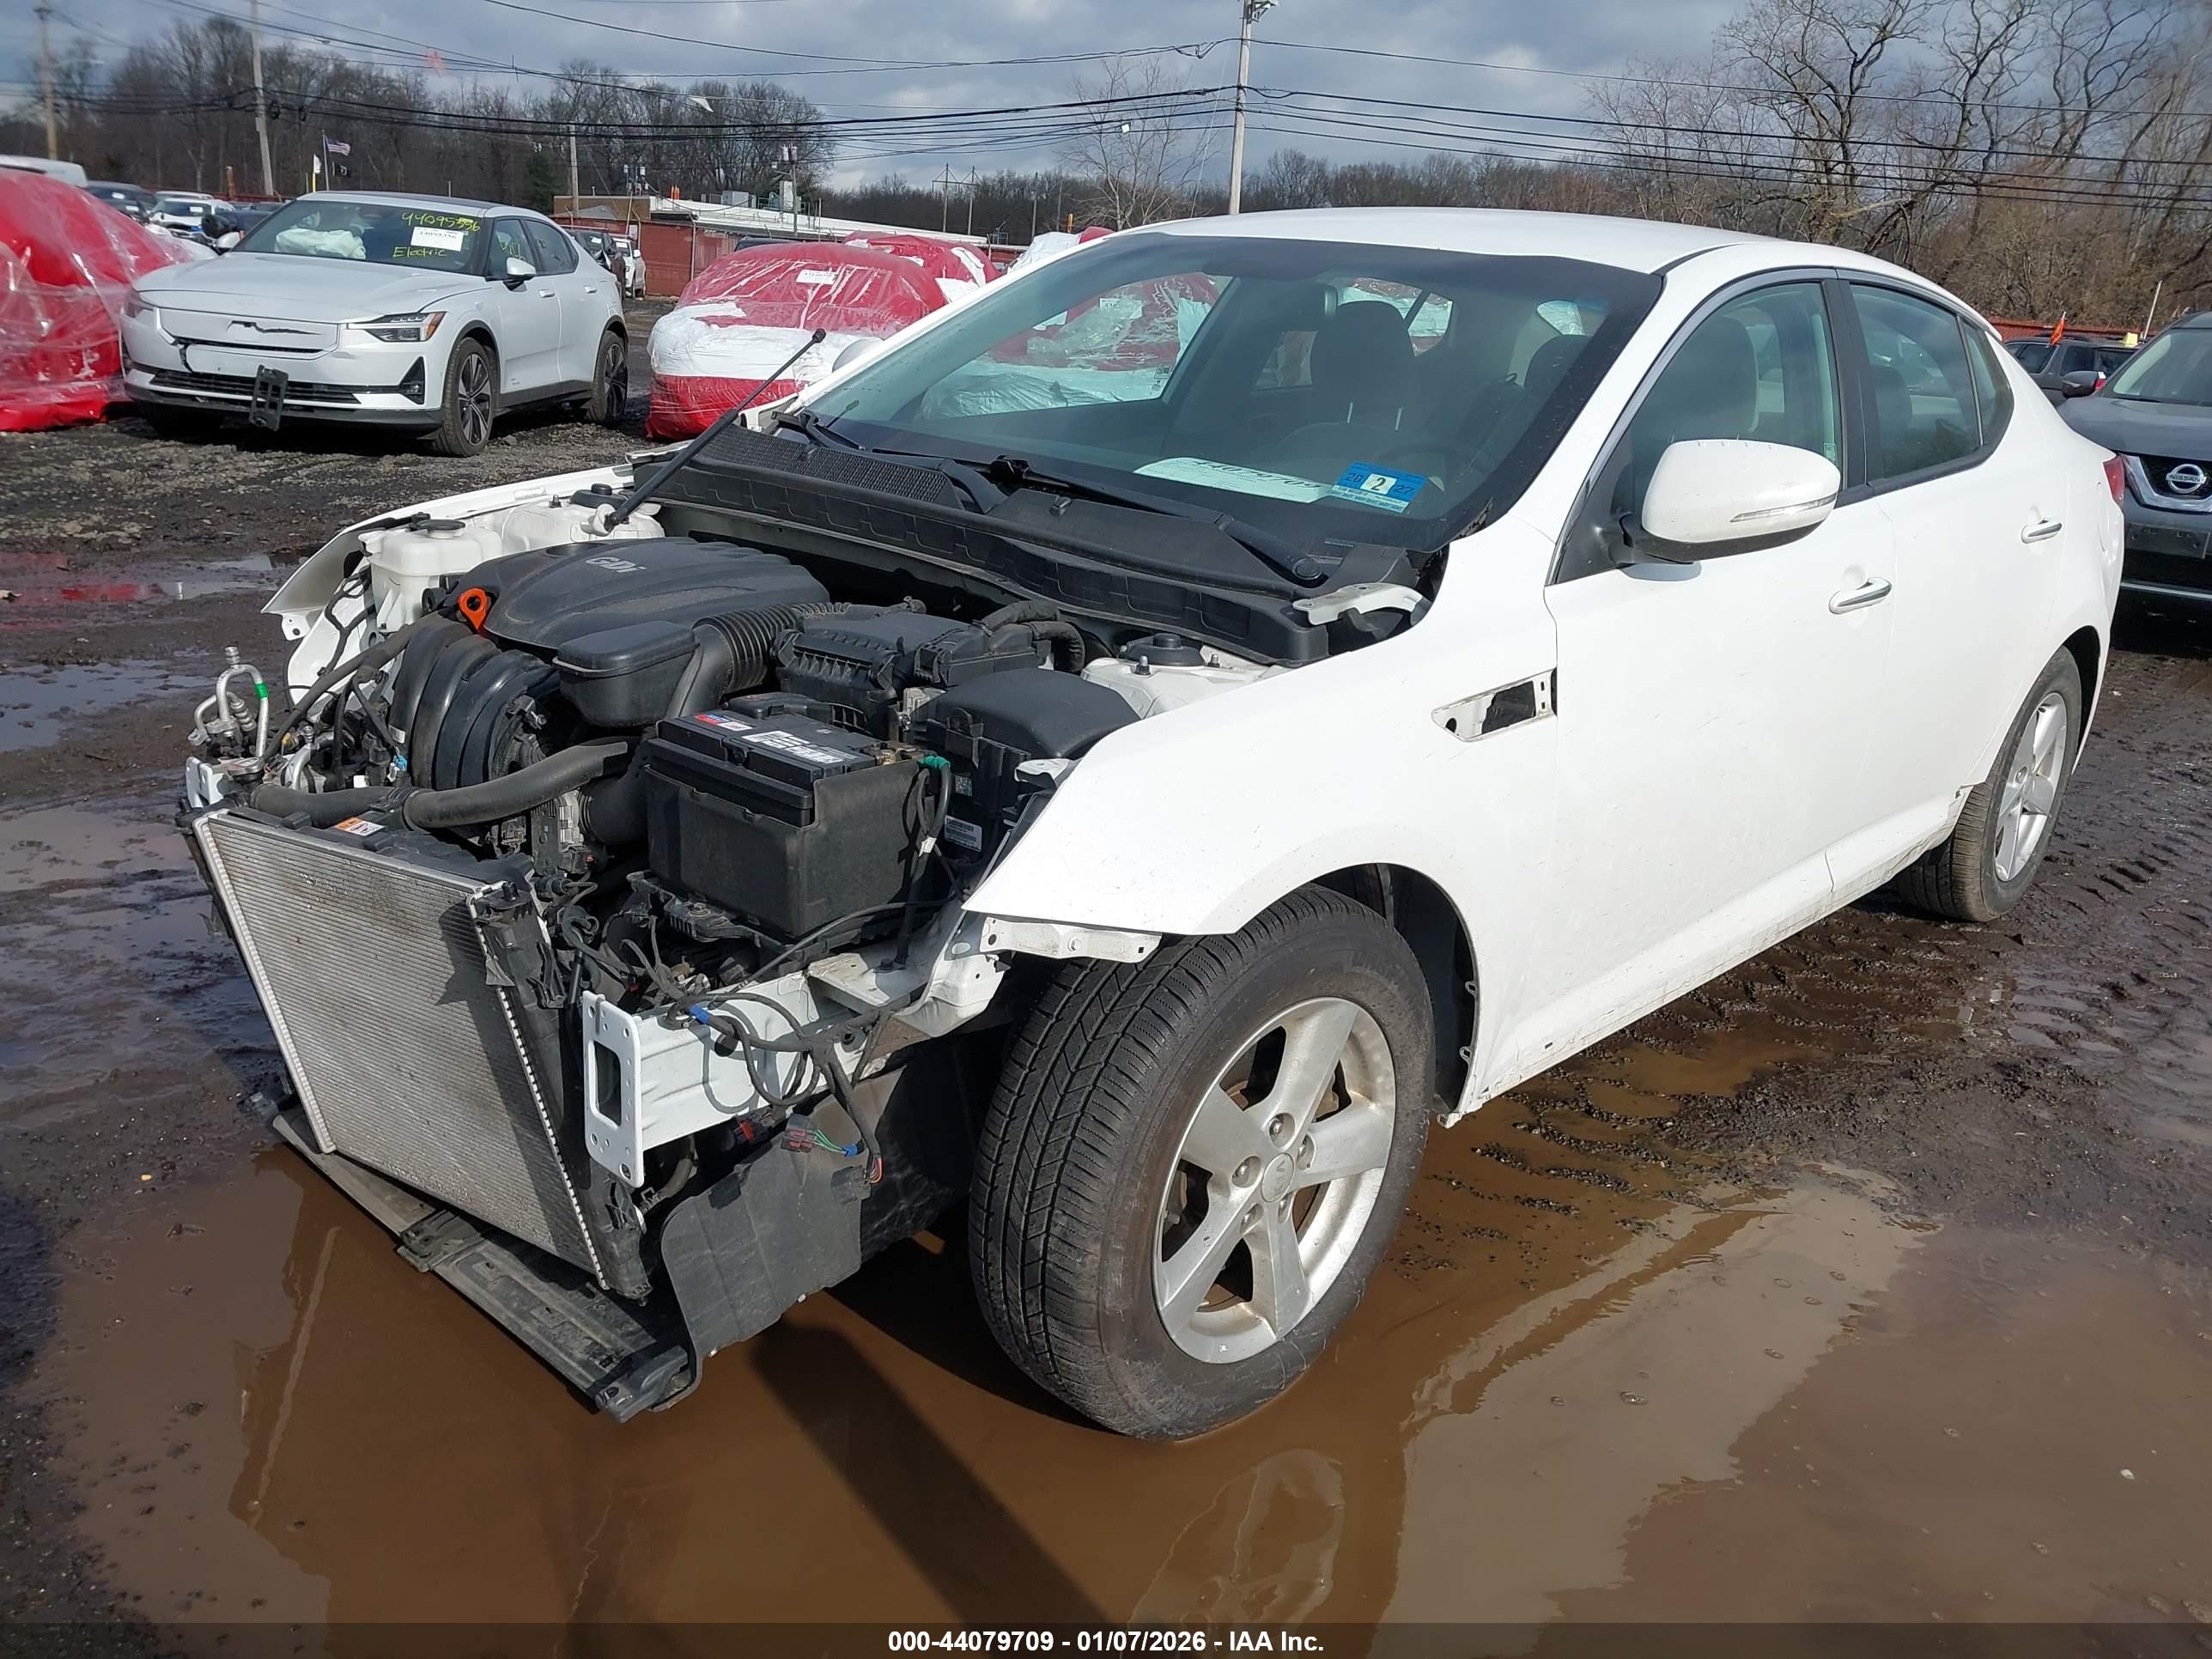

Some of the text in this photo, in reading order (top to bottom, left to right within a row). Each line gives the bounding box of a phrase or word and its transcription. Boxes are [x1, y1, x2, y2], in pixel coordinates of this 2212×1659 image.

[392, 246, 447, 258] Electric
[1345, 472, 1415, 495] 20 2 27
[2169, 474, 2201, 483] NISSAN
